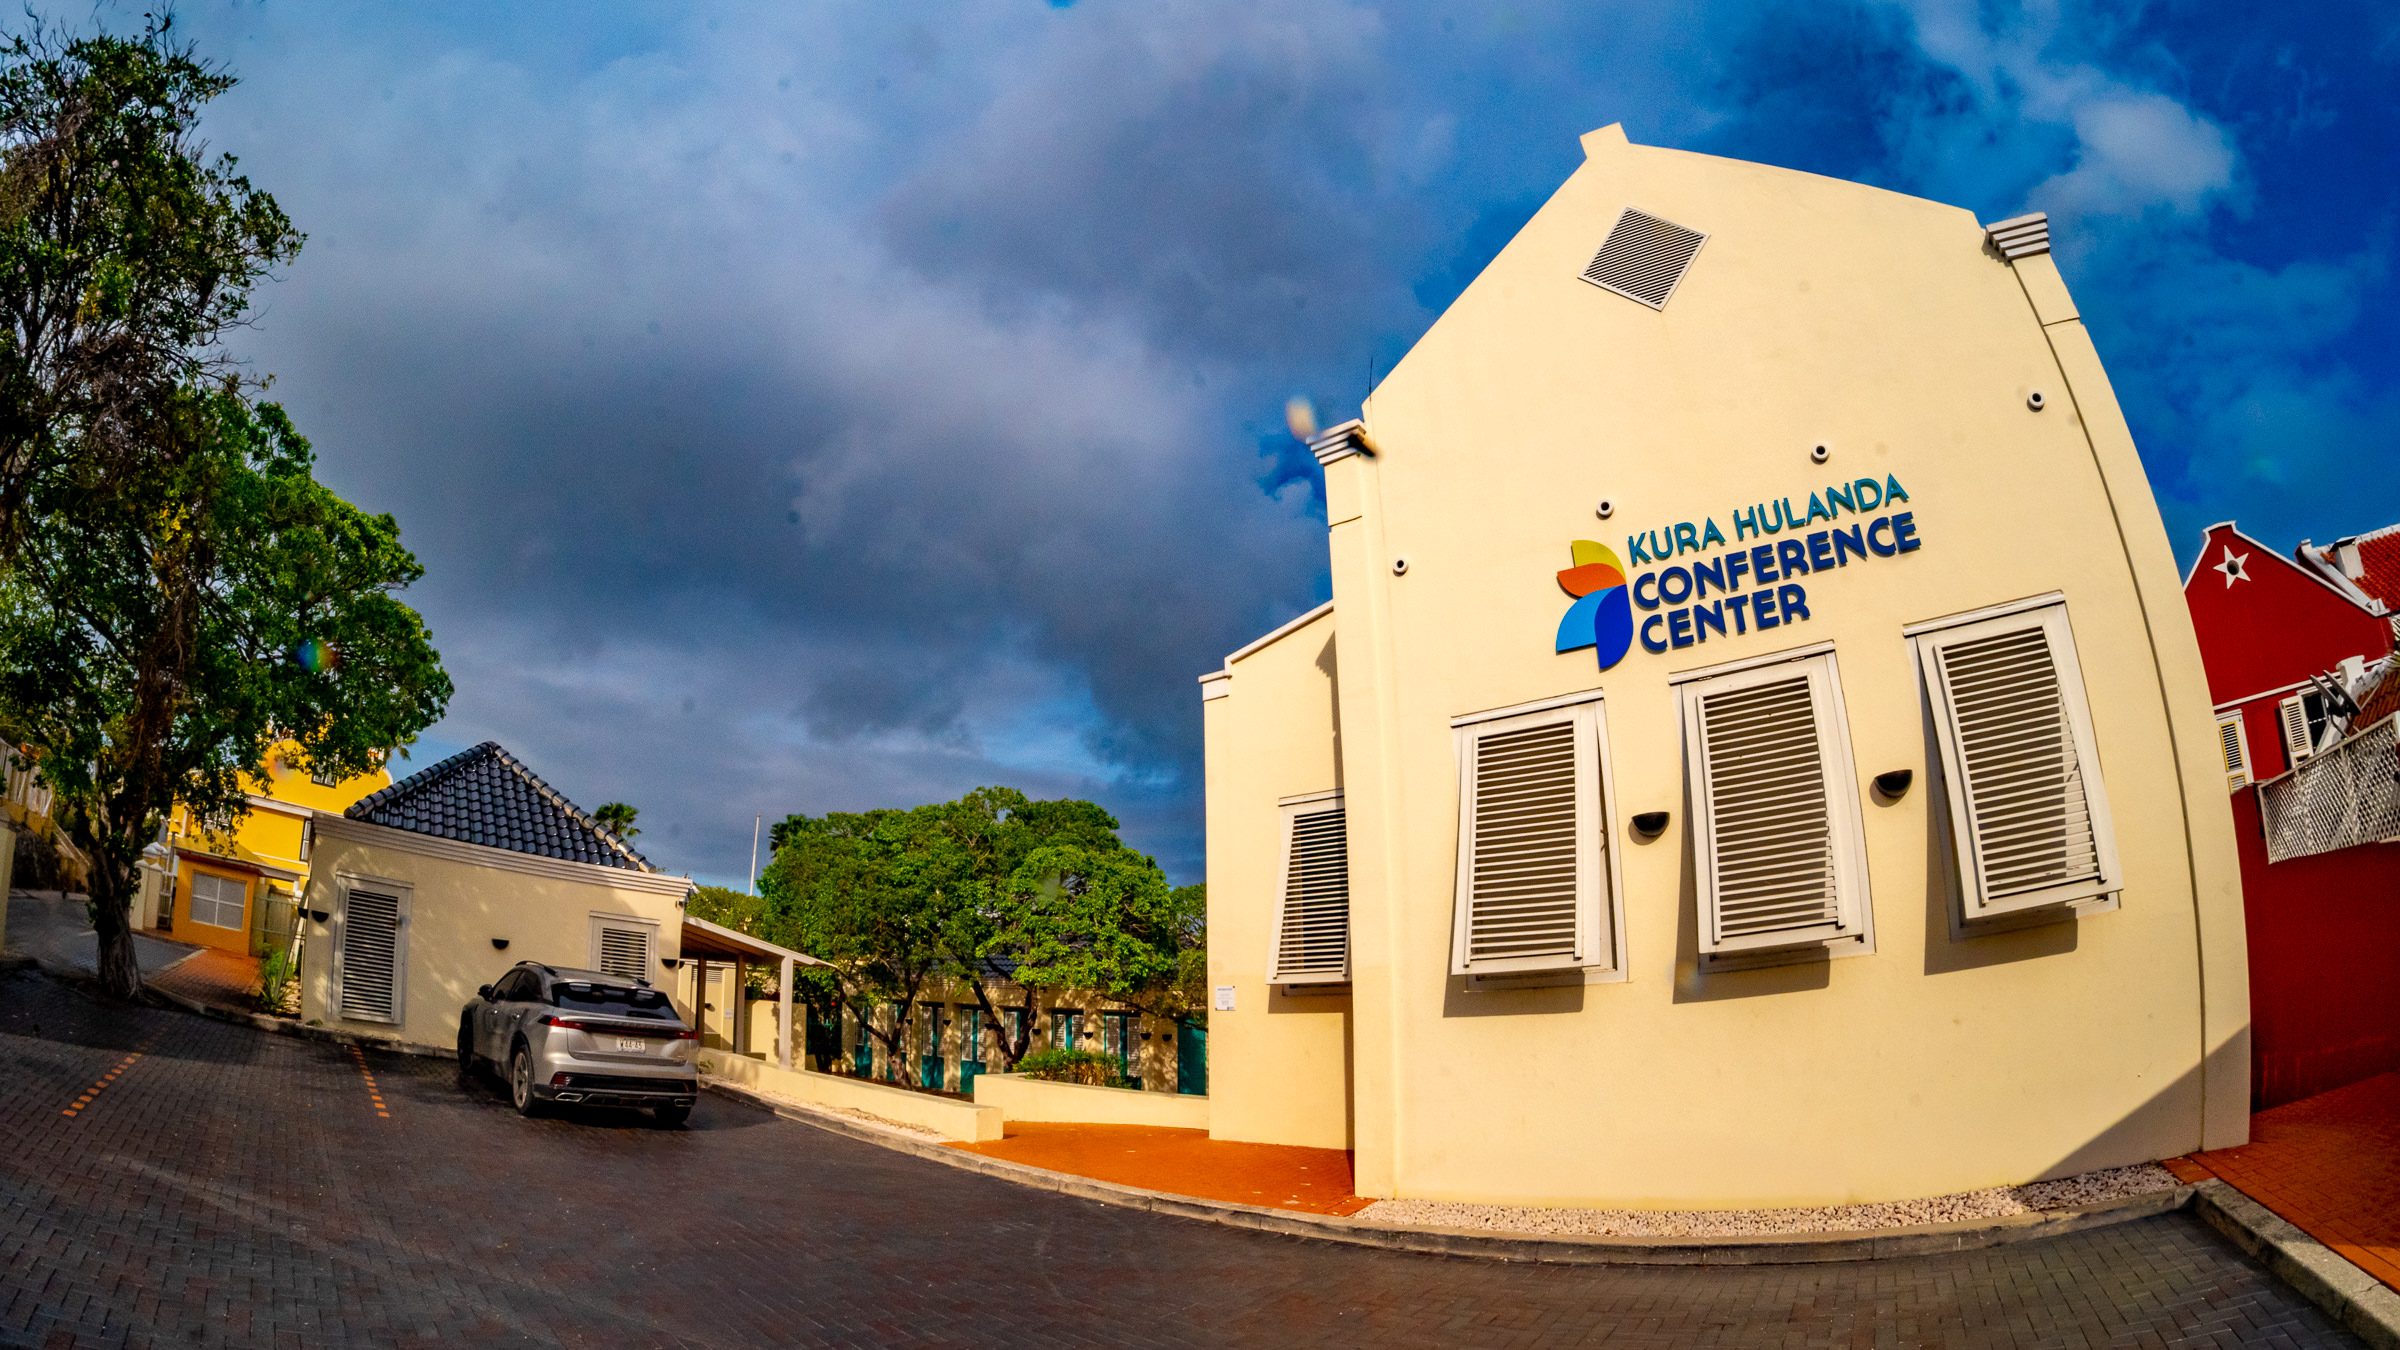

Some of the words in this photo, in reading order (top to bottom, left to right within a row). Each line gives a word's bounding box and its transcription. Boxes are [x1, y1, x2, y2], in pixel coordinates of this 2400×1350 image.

[1628, 517, 1725, 566] KURA
[1734, 474, 1909, 541] HULANDA
[1634, 511, 1921, 610] CONFERENCE
[1641, 584, 1810, 654] CENTER
